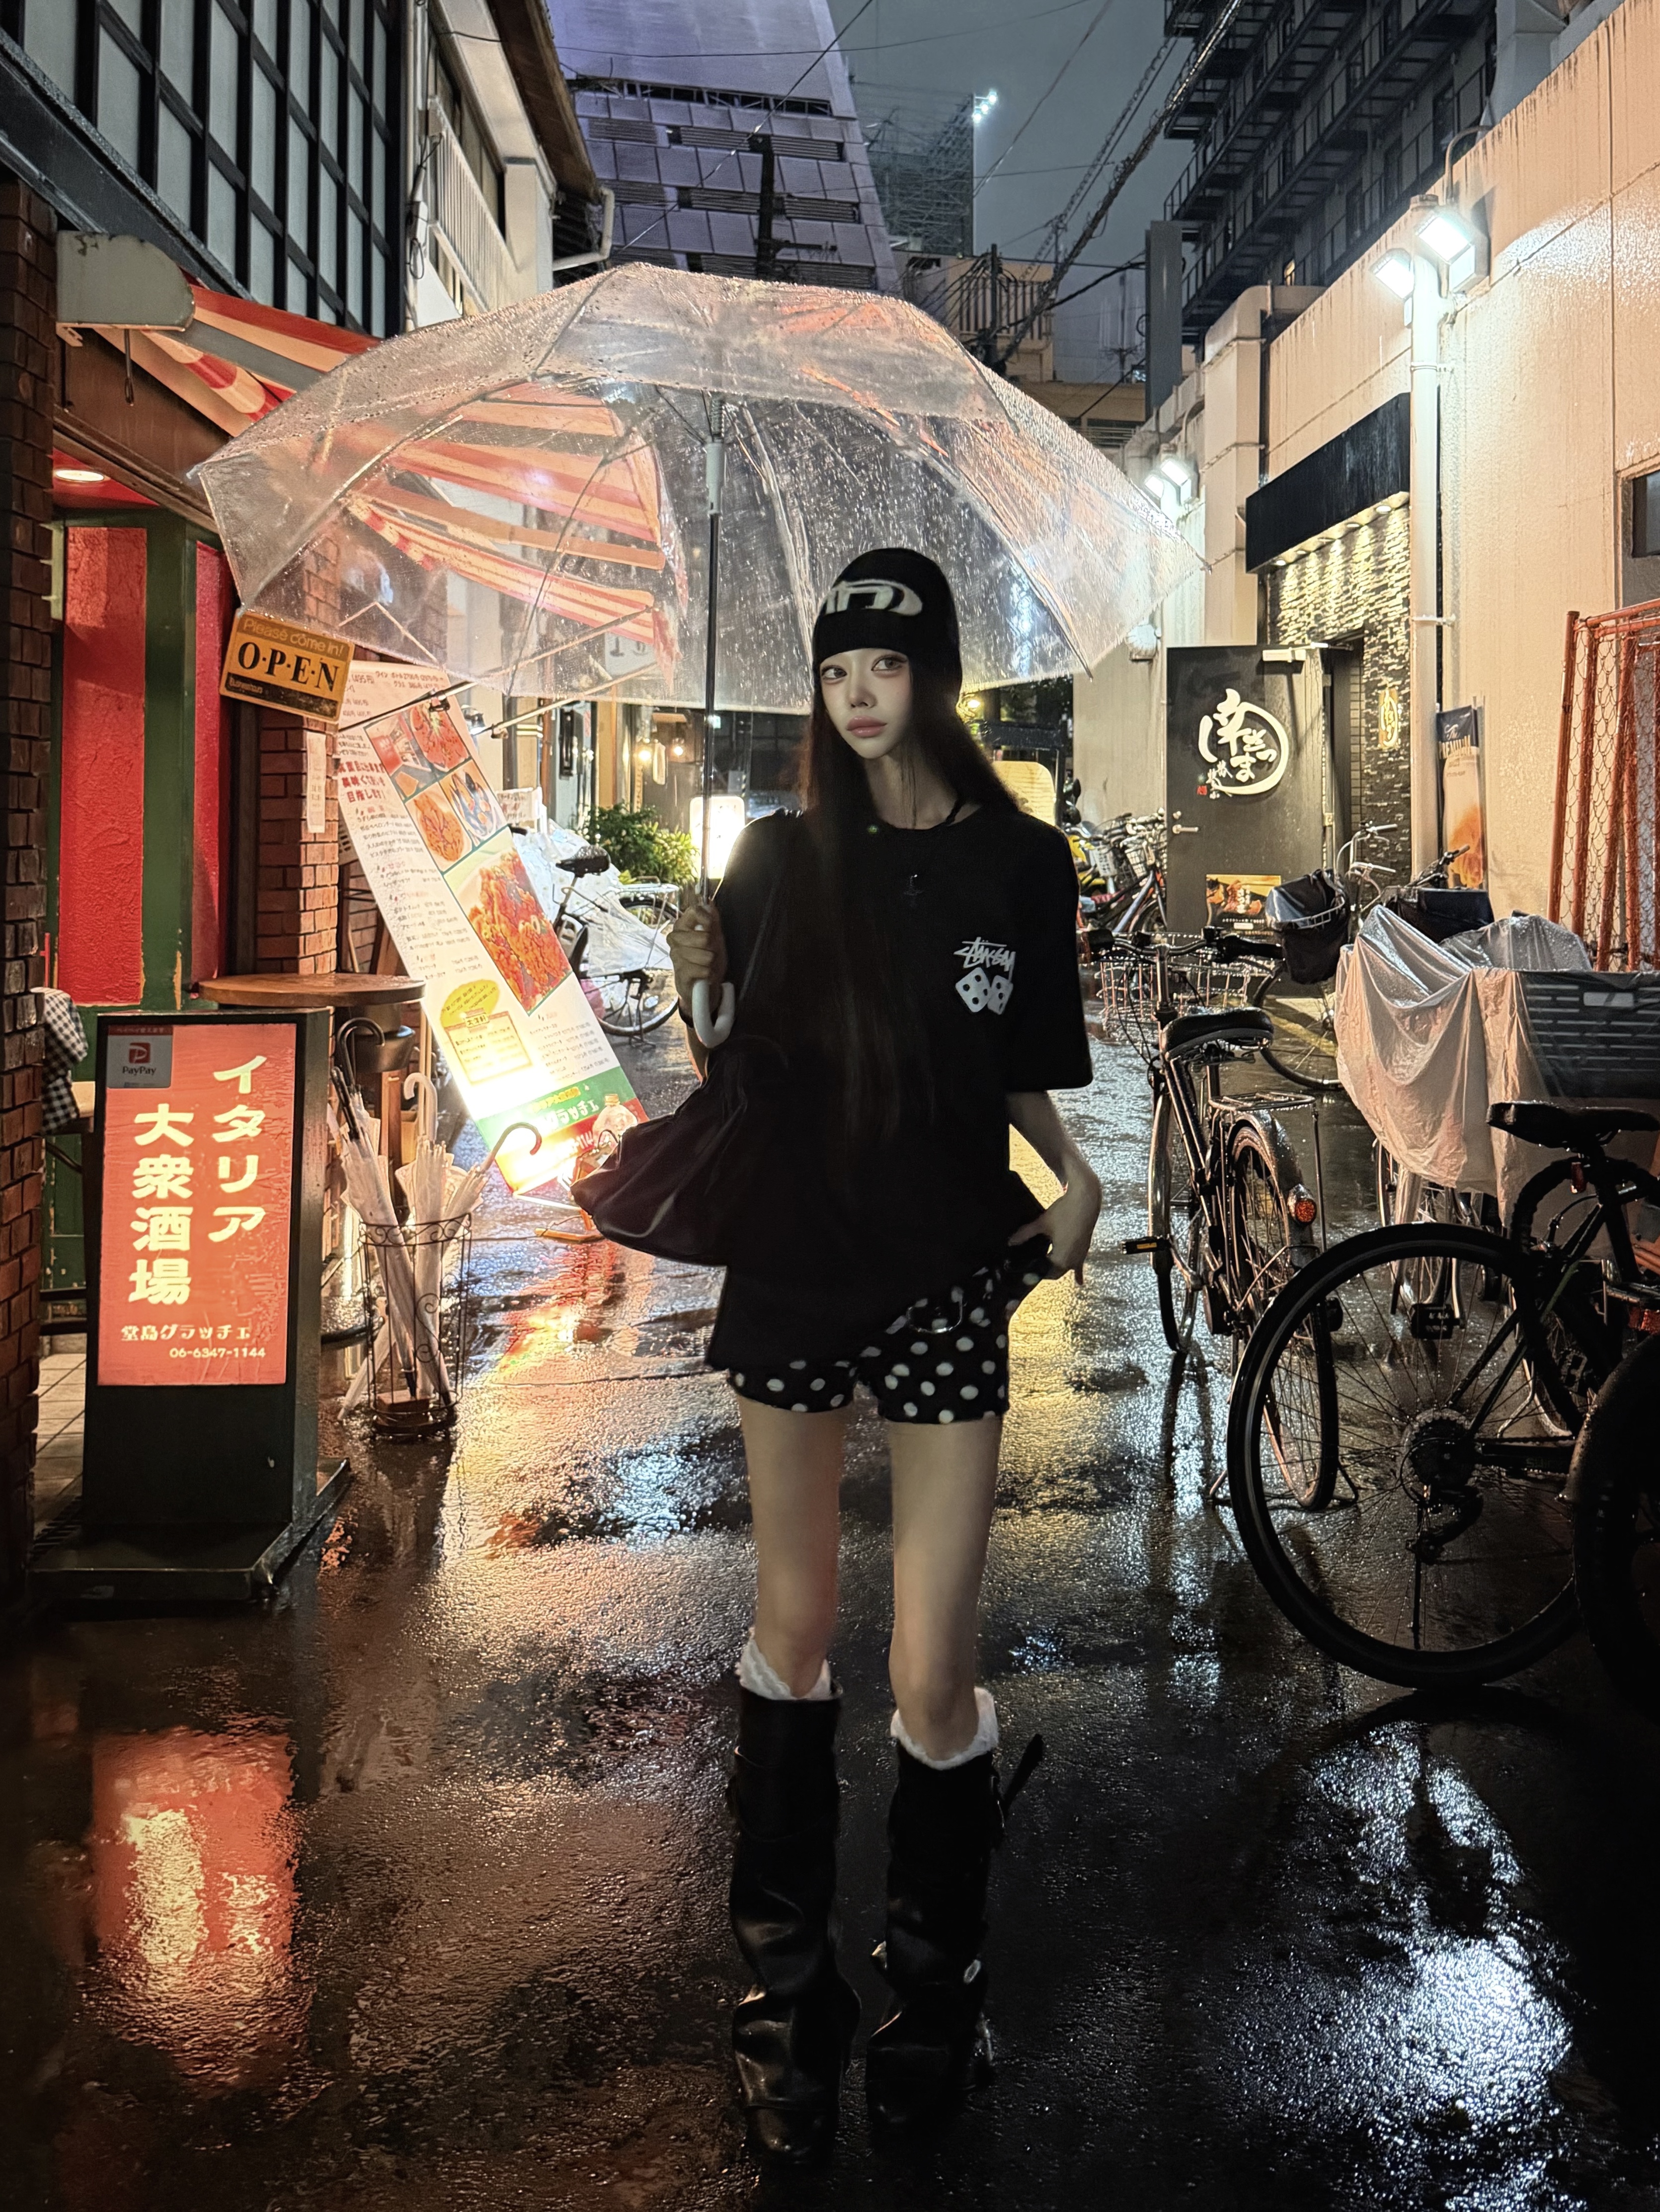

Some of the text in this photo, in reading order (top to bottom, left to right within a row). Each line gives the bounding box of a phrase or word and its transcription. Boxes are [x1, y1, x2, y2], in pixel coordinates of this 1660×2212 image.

[243, 619, 289, 642] Please
[290, 633, 326, 652] come
[122, 1066, 157, 1076] PayPay
[209, 1055, 267, 1243] イタリア
[128, 1103, 194, 1305] 大衆酒場
[121, 1324, 250, 1342] 堂島グラッチェ
[169, 1347, 266, 1359] 06-6347-1144
